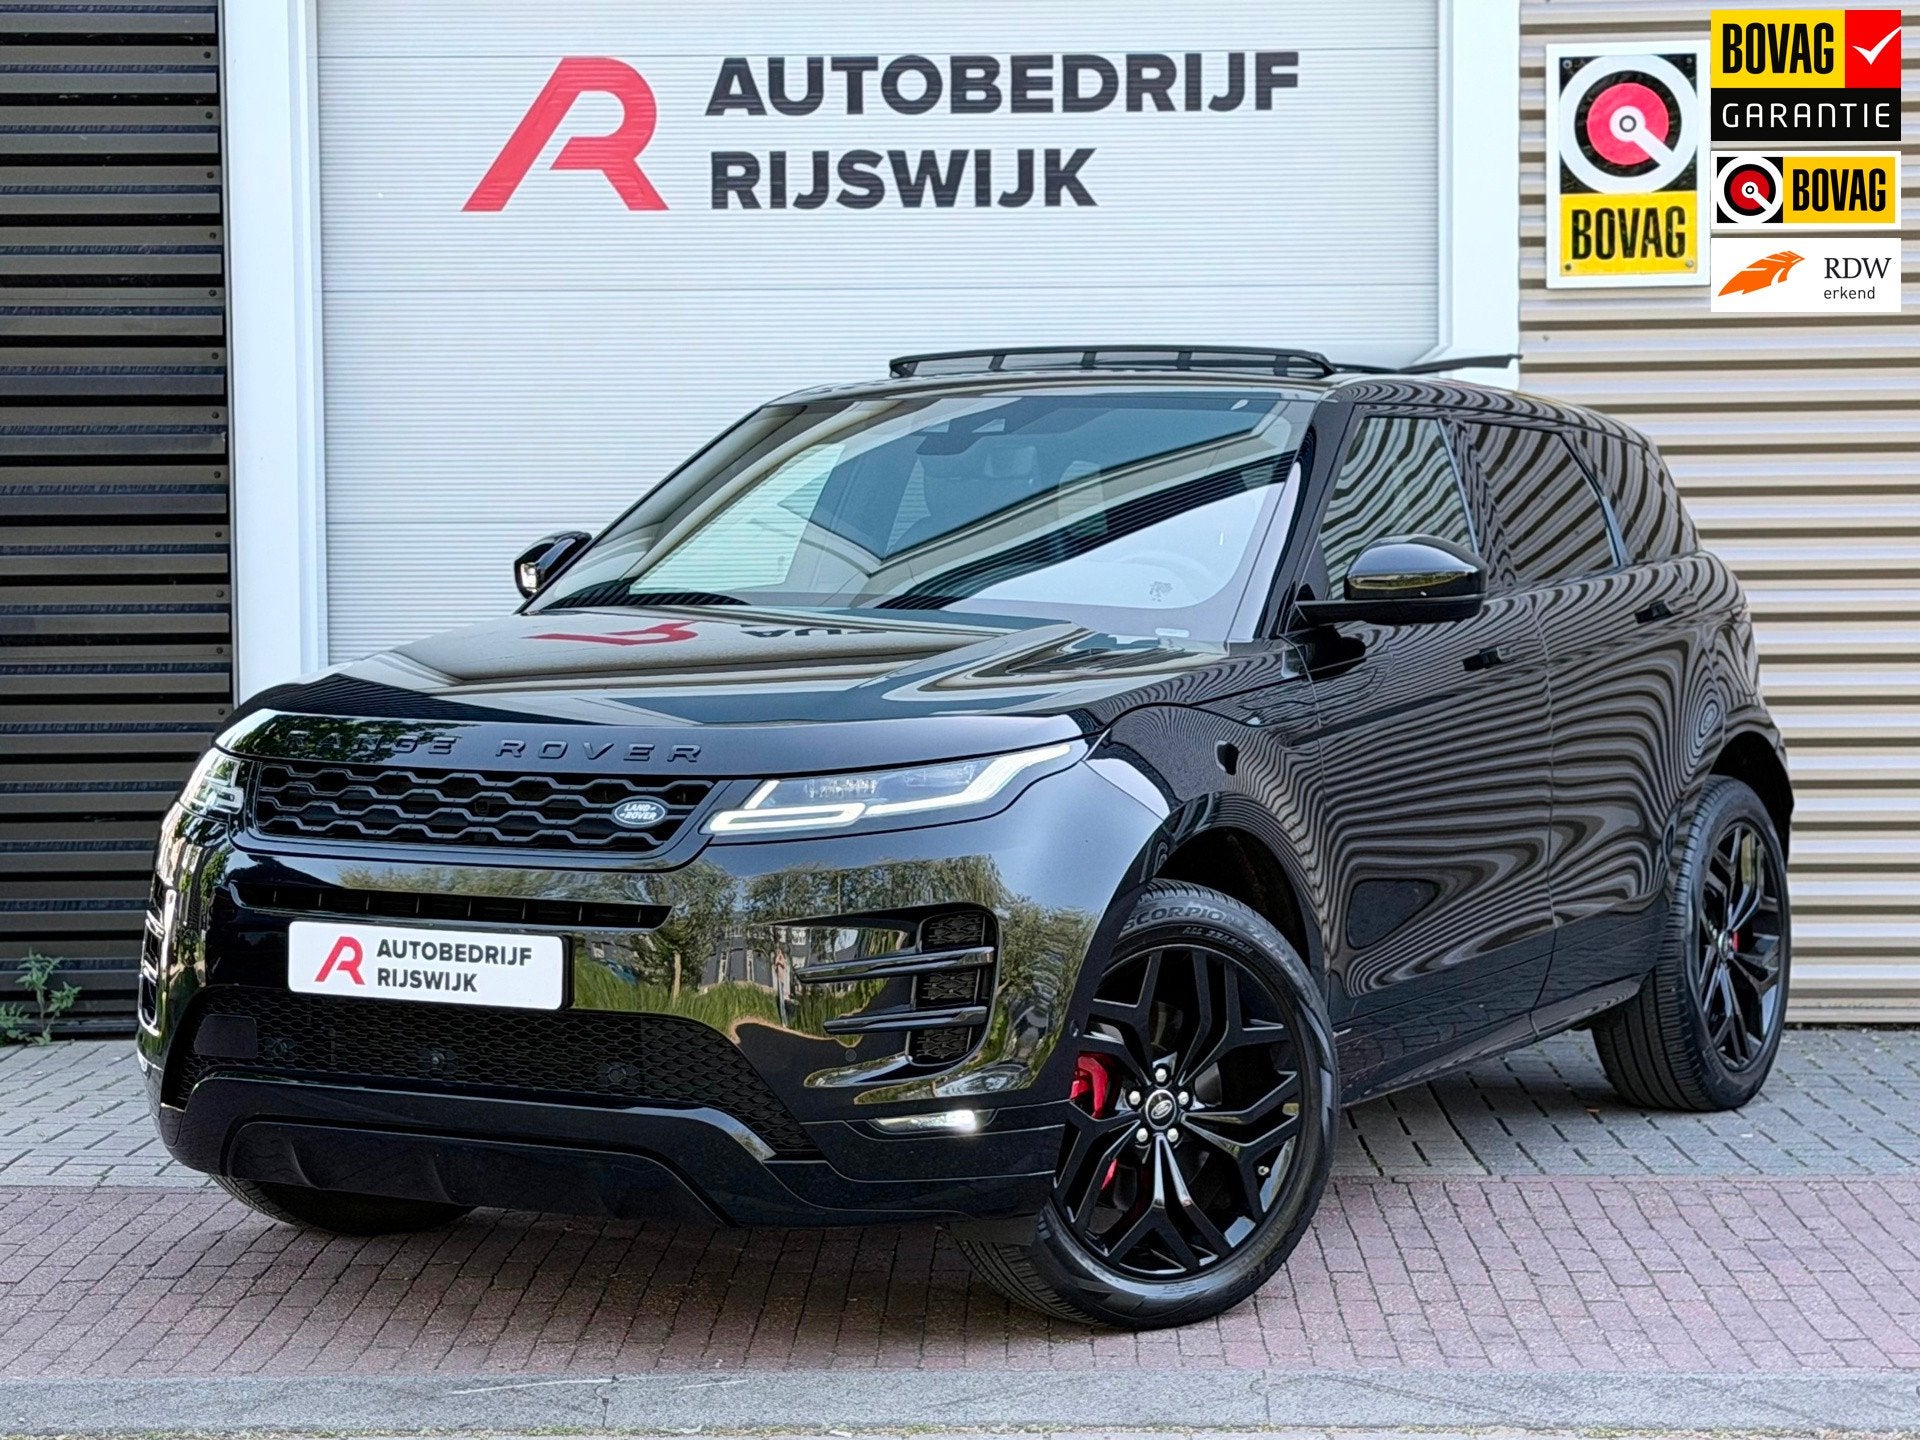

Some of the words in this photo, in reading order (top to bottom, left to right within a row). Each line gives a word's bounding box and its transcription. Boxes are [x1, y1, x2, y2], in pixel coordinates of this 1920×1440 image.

[705, 51, 1299, 116] AUTOBEDRIJF
[711, 147, 1098, 210] RIJSWIJK
[1571, 206, 1686, 260] BOVAG
[495, 738, 703, 763] ROVER
[377, 938, 532, 967] AUTOBEDRIJF
[377, 968, 477, 992] RIJSWIJK
